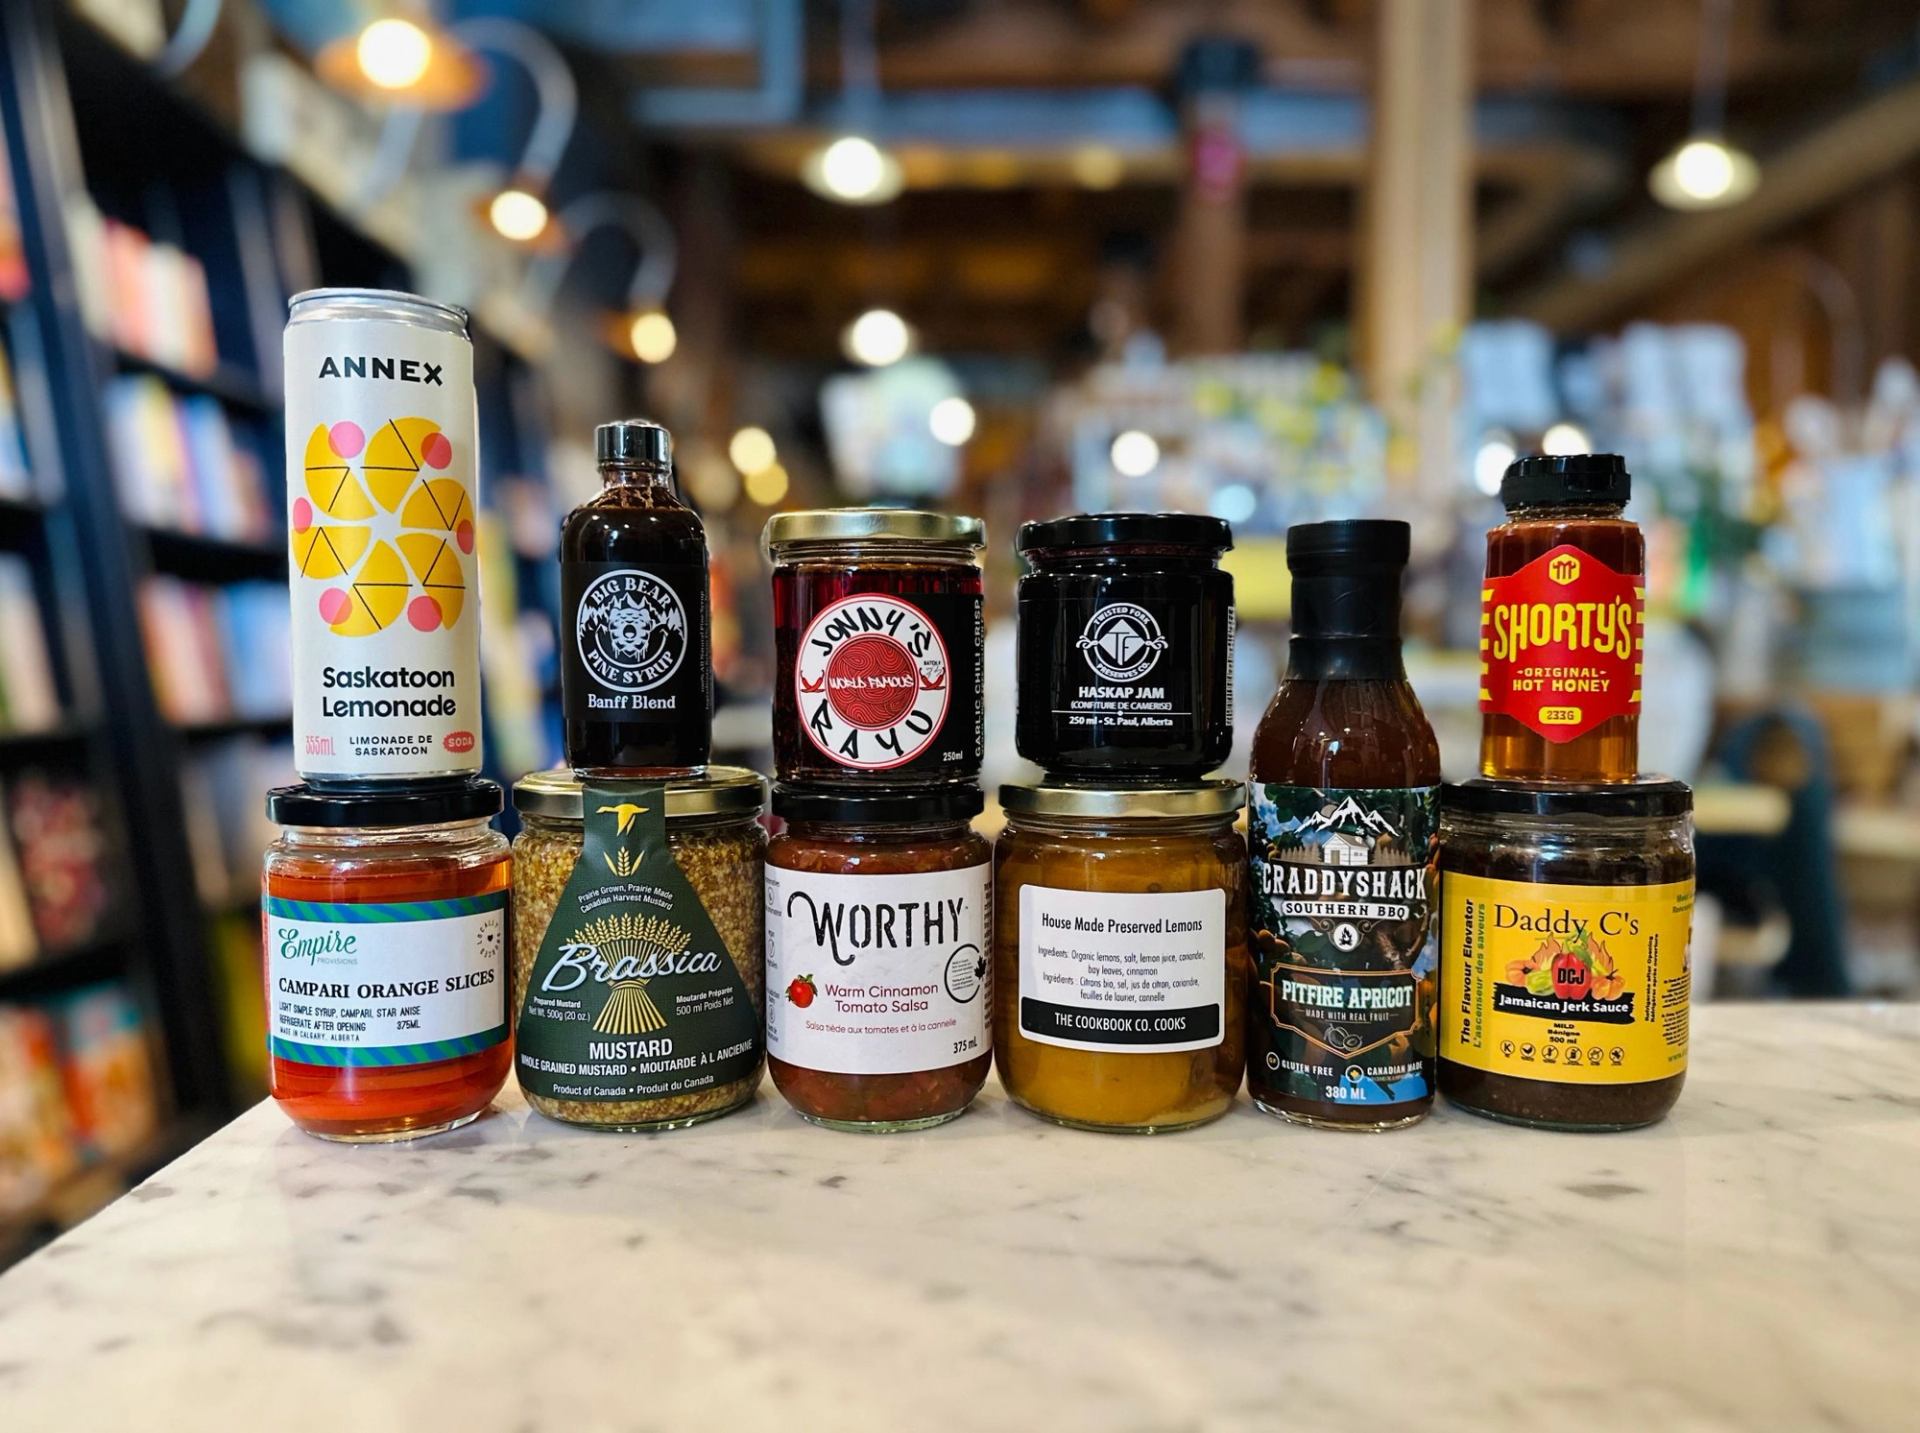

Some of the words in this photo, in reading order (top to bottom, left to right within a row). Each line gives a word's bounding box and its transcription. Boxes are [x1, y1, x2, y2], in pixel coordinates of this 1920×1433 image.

[319, 356, 443, 387] ANNEX
[591, 580, 620, 605] BIG
[625, 577, 671, 608] BEAR
[1093, 606, 1128, 626] TWISTED
[1129, 607, 1151, 626] FORK
[811, 606, 932, 658] JONNY'S
[1493, 595, 1632, 663] SHORTY'S
[587, 650, 620, 681] PINE
[622, 651, 674, 684] SYRUP
[1096, 662, 1138, 679] PRESERVES
[1524, 667, 1599, 678] ORIGINAL
[322, 666, 455, 688] Saskatoon
[829, 675, 867, 690] WORLD
[867, 674, 914, 690] FAMOUS
[1512, 679, 1544, 692] HOT
[1551, 679, 1611, 693] HONEY
[588, 693, 629, 709] Banff
[632, 694, 676, 709] Blend
[1078, 686, 1134, 699] HASKAP
[1135, 687, 1165, 699] JAM
[322, 694, 456, 718] Lemonade
[1070, 700, 1116, 710] (CONFITURE
[1117, 701, 1128, 710] DE
[1130, 701, 1172, 711] CAMERISE)
[1069, 716, 1084, 725] 250
[1085, 716, 1097, 725] ml
[1103, 716, 1116, 725] St.
[1117, 716, 1139, 727] Paul,
[1140, 717, 1173, 726] Alberta
[1546, 710, 1575, 721] 233G
[811, 698, 934, 760] RAYU
[305, 735, 336, 756] 355mL
[350, 735, 414, 745] LIMONADE
[418, 735, 433, 744] DE
[448, 737, 474, 748] SODA
[355, 746, 428, 756] SASKATOON
[943, 751, 963, 761] 250ml
[1262, 862, 1427, 900] CRADDYSHACK
[578, 889, 600, 904] Prairie
[600, 885, 627, 895] Grown,
[628, 883, 652, 893] Prairie
[653, 887, 673, 900] Made
[580, 897, 612, 913] Canadian
[613, 894, 642, 902] Harvest
[643, 894, 673, 911] Mustard
[1285, 902, 1370, 916] SOUTHERN
[1377, 906, 1406, 919] BBQ
[787, 891, 964, 966] WORTHY
[1042, 912, 1072, 930] House
[1074, 916, 1105, 933] Made
[1107, 918, 1163, 934] Preserved
[1165, 919, 1203, 934] Lemons
[1462, 898, 1474, 958] Elevator
[1475, 903, 1485, 950] saveurs
[1494, 904, 1588, 943] Daddy
[1599, 911, 1639, 936] C's
[278, 927, 357, 966] Empire
[1071, 949, 1095, 962] Organic
[1139, 952, 1160, 963] lemon
[1474, 953, 1483, 974] des
[541, 942, 722, 992] Brassica
[1088, 965, 1100, 976] bay
[1101, 966, 1125, 977] leaves,
[1126, 966, 1158, 976] cinnamon
[279, 978, 350, 999] CAMPARI
[357, 979, 439, 999] ORANGE
[445, 969, 495, 993] SLICES
[1080, 976, 1101, 988] Citrons
[1141, 980, 1150, 990] de
[1557, 968, 1585, 985] DCJ
[825, 983, 865, 998] Warm
[868, 982, 939, 998] Cinnamon
[1080, 989, 1103, 1001] feuilles
[1104, 991, 1113, 1001] de
[1138, 991, 1165, 1002] cannelle
[1281, 979, 1345, 1009] PITFIRE
[1347, 986, 1413, 1009] APRICOT
[1461, 961, 1472, 1014] Flavour
[533, 995, 556, 1006] Prepared
[557, 999, 582, 1008] Mustard
[676, 993, 707, 1004] Moutarde
[676, 1004, 691, 1016] 500
[703, 998, 722, 1011] Poids
[723, 996, 734, 1006] Net
[835, 999, 888, 1014] Tomato
[892, 999, 929, 1013] Salsa
[1498, 993, 1560, 1010] Jamaican
[1561, 1001, 1590, 1013] Jerk
[1592, 1002, 1629, 1012] Sauce
[314, 1006, 339, 1018] SYRUP,
[376, 1008, 397, 1018] STAR
[399, 1006, 421, 1017] ANISE
[546, 1009, 563, 1021] 500g
[564, 1011, 576, 1021] (20
[1305, 1009, 1324, 1019] MADE
[1328, 1011, 1346, 1021] WITH
[1349, 1012, 1367, 1022] REAL
[1369, 1012, 1389, 1022] FRUIT
[1473, 976, 1483, 1048] L'ascenseur
[279, 1014, 312, 1029] REFRIGERATE
[313, 1020, 335, 1031] AFTER
[336, 1021, 366, 1032] OPENING
[396, 1020, 421, 1031] 375ML
[805, 1020, 825, 1031] Salsa
[825, 1023, 846, 1034] tiède
[847, 1026, 863, 1034] aux
[864, 1025, 899, 1035] tomates
[900, 1024, 909, 1033] et
[927, 1017, 957, 1031] cannelle
[1055, 1012, 1072, 1027] THE
[1075, 1015, 1132, 1032] COOKBOOK
[1135, 1018, 1152, 1032] CO.
[1154, 1017, 1186, 1032] COOKS
[1460, 1018, 1471, 1044] The
[330, 1034, 360, 1042] ALBERTA
[1547, 1029, 1581, 1037] Bénigne
[589, 1038, 673, 1061] MUSTARD
[953, 1040, 968, 1054] 375
[968, 1036, 978, 1050] mL
[521, 1053, 540, 1070] WHOLE
[541, 1060, 576, 1075] GRAINED
[579, 1064, 628, 1077] MUSTARD
[639, 1056, 697, 1074] MOUTARDE
[700, 1051, 708, 1065] À
[1281, 1060, 1310, 1073] GLUTEN
[1312, 1065, 1334, 1077] FREE
[1367, 1064, 1406, 1076] CANADIAN
[1407, 1060, 1423, 1071] MADE
[553, 1083, 583, 1094] Product
[593, 1086, 626, 1096] Canada
[636, 1082, 669, 1095] Produit
[671, 1081, 682, 1091] du
[684, 1074, 714, 1090] Canada
[1325, 1085, 1347, 1099] 380
[1350, 1087, 1366, 1100] ML
